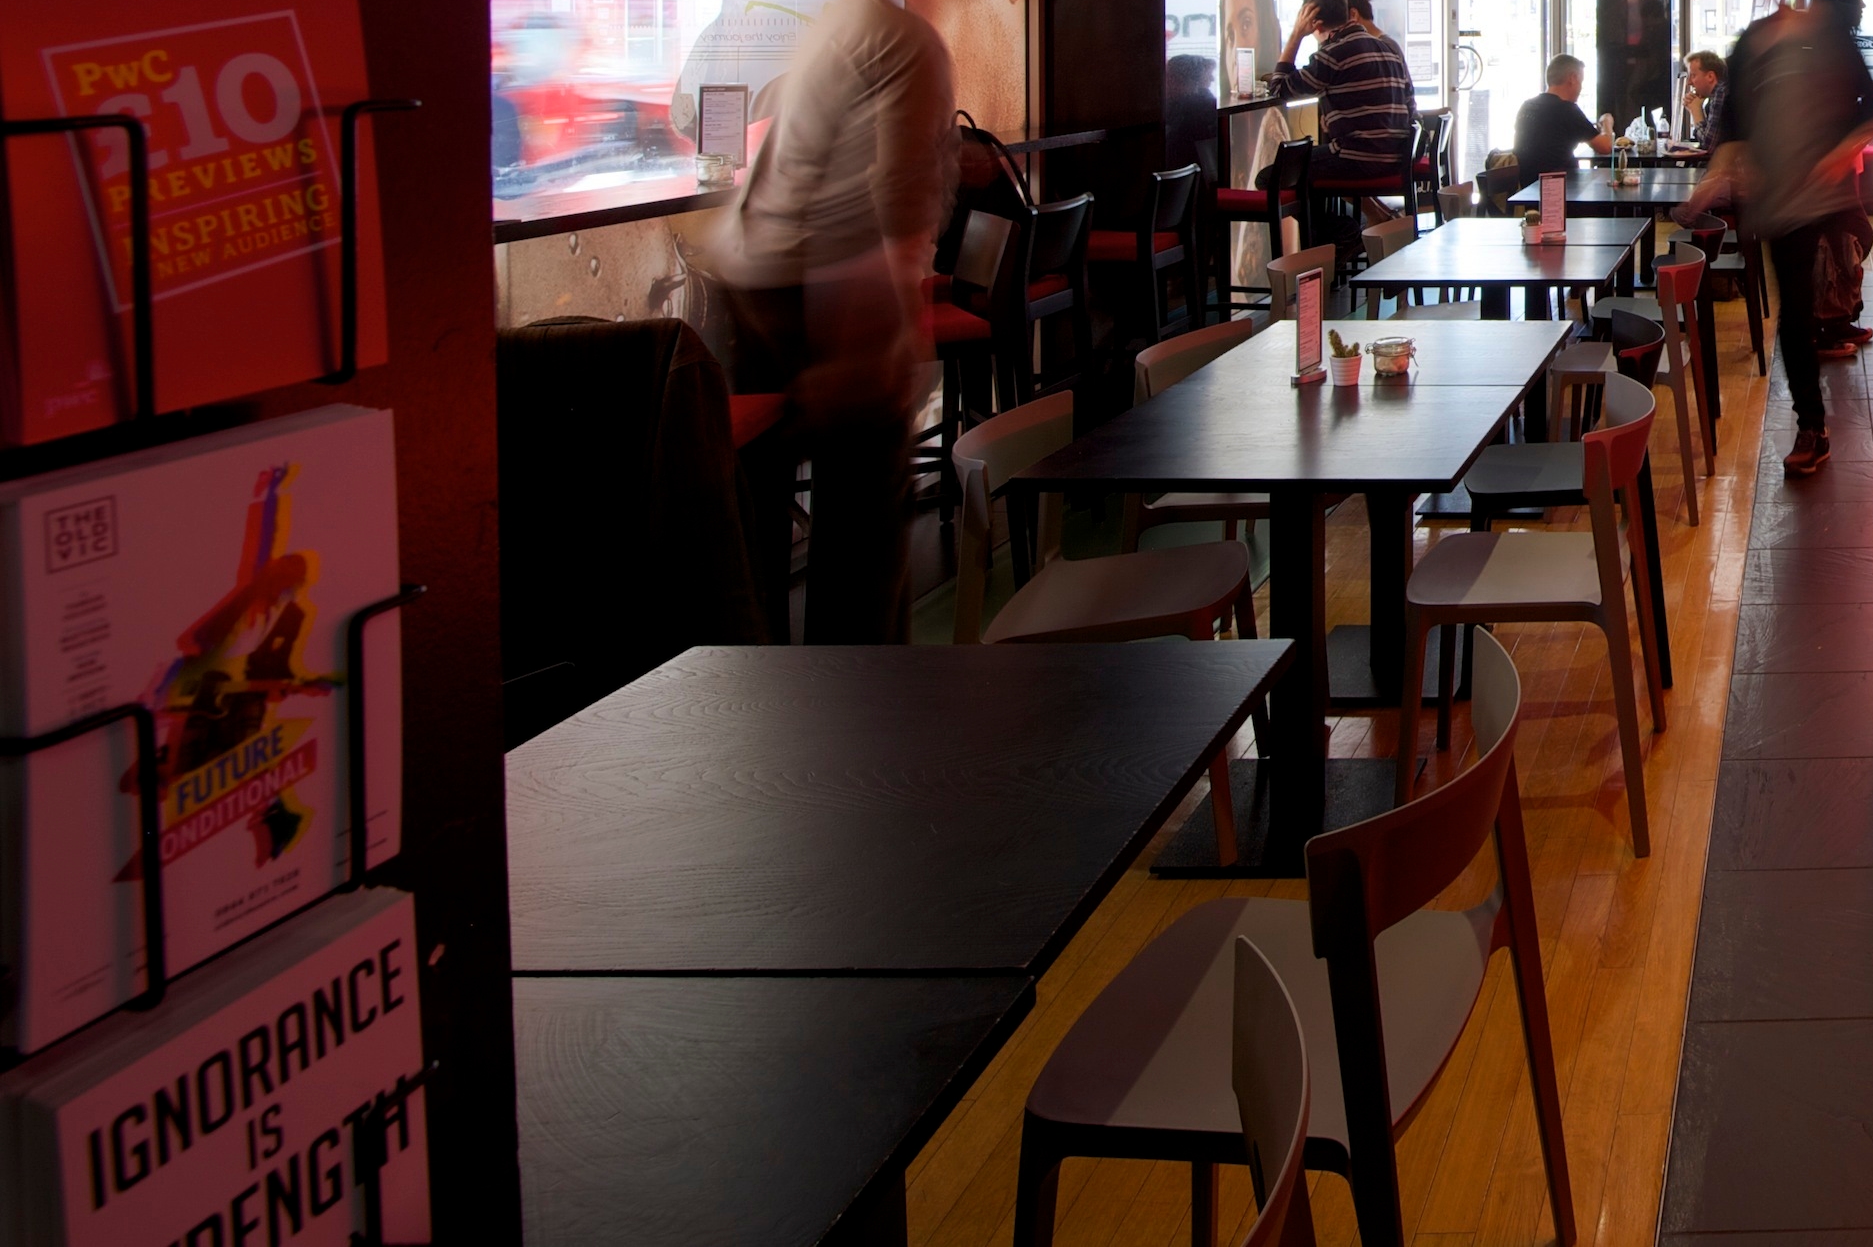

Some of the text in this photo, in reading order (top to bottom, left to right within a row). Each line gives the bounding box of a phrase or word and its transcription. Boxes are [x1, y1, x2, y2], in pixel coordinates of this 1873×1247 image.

[71, 49, 174, 97] PwC
[95, 52, 303, 181] £10
[106, 137, 319, 214] PREVIEWS
[122, 182, 331, 266] INSPIRING
[155, 211, 337, 281] NEW AUDIENCE
[55, 505, 108, 534] THE
[160, 752, 311, 860] ONDITIONAL
[176, 724, 285, 816] FUTURE
[88, 938, 405, 1212] IGNORANCE
[248, 1103, 284, 1171] IS
